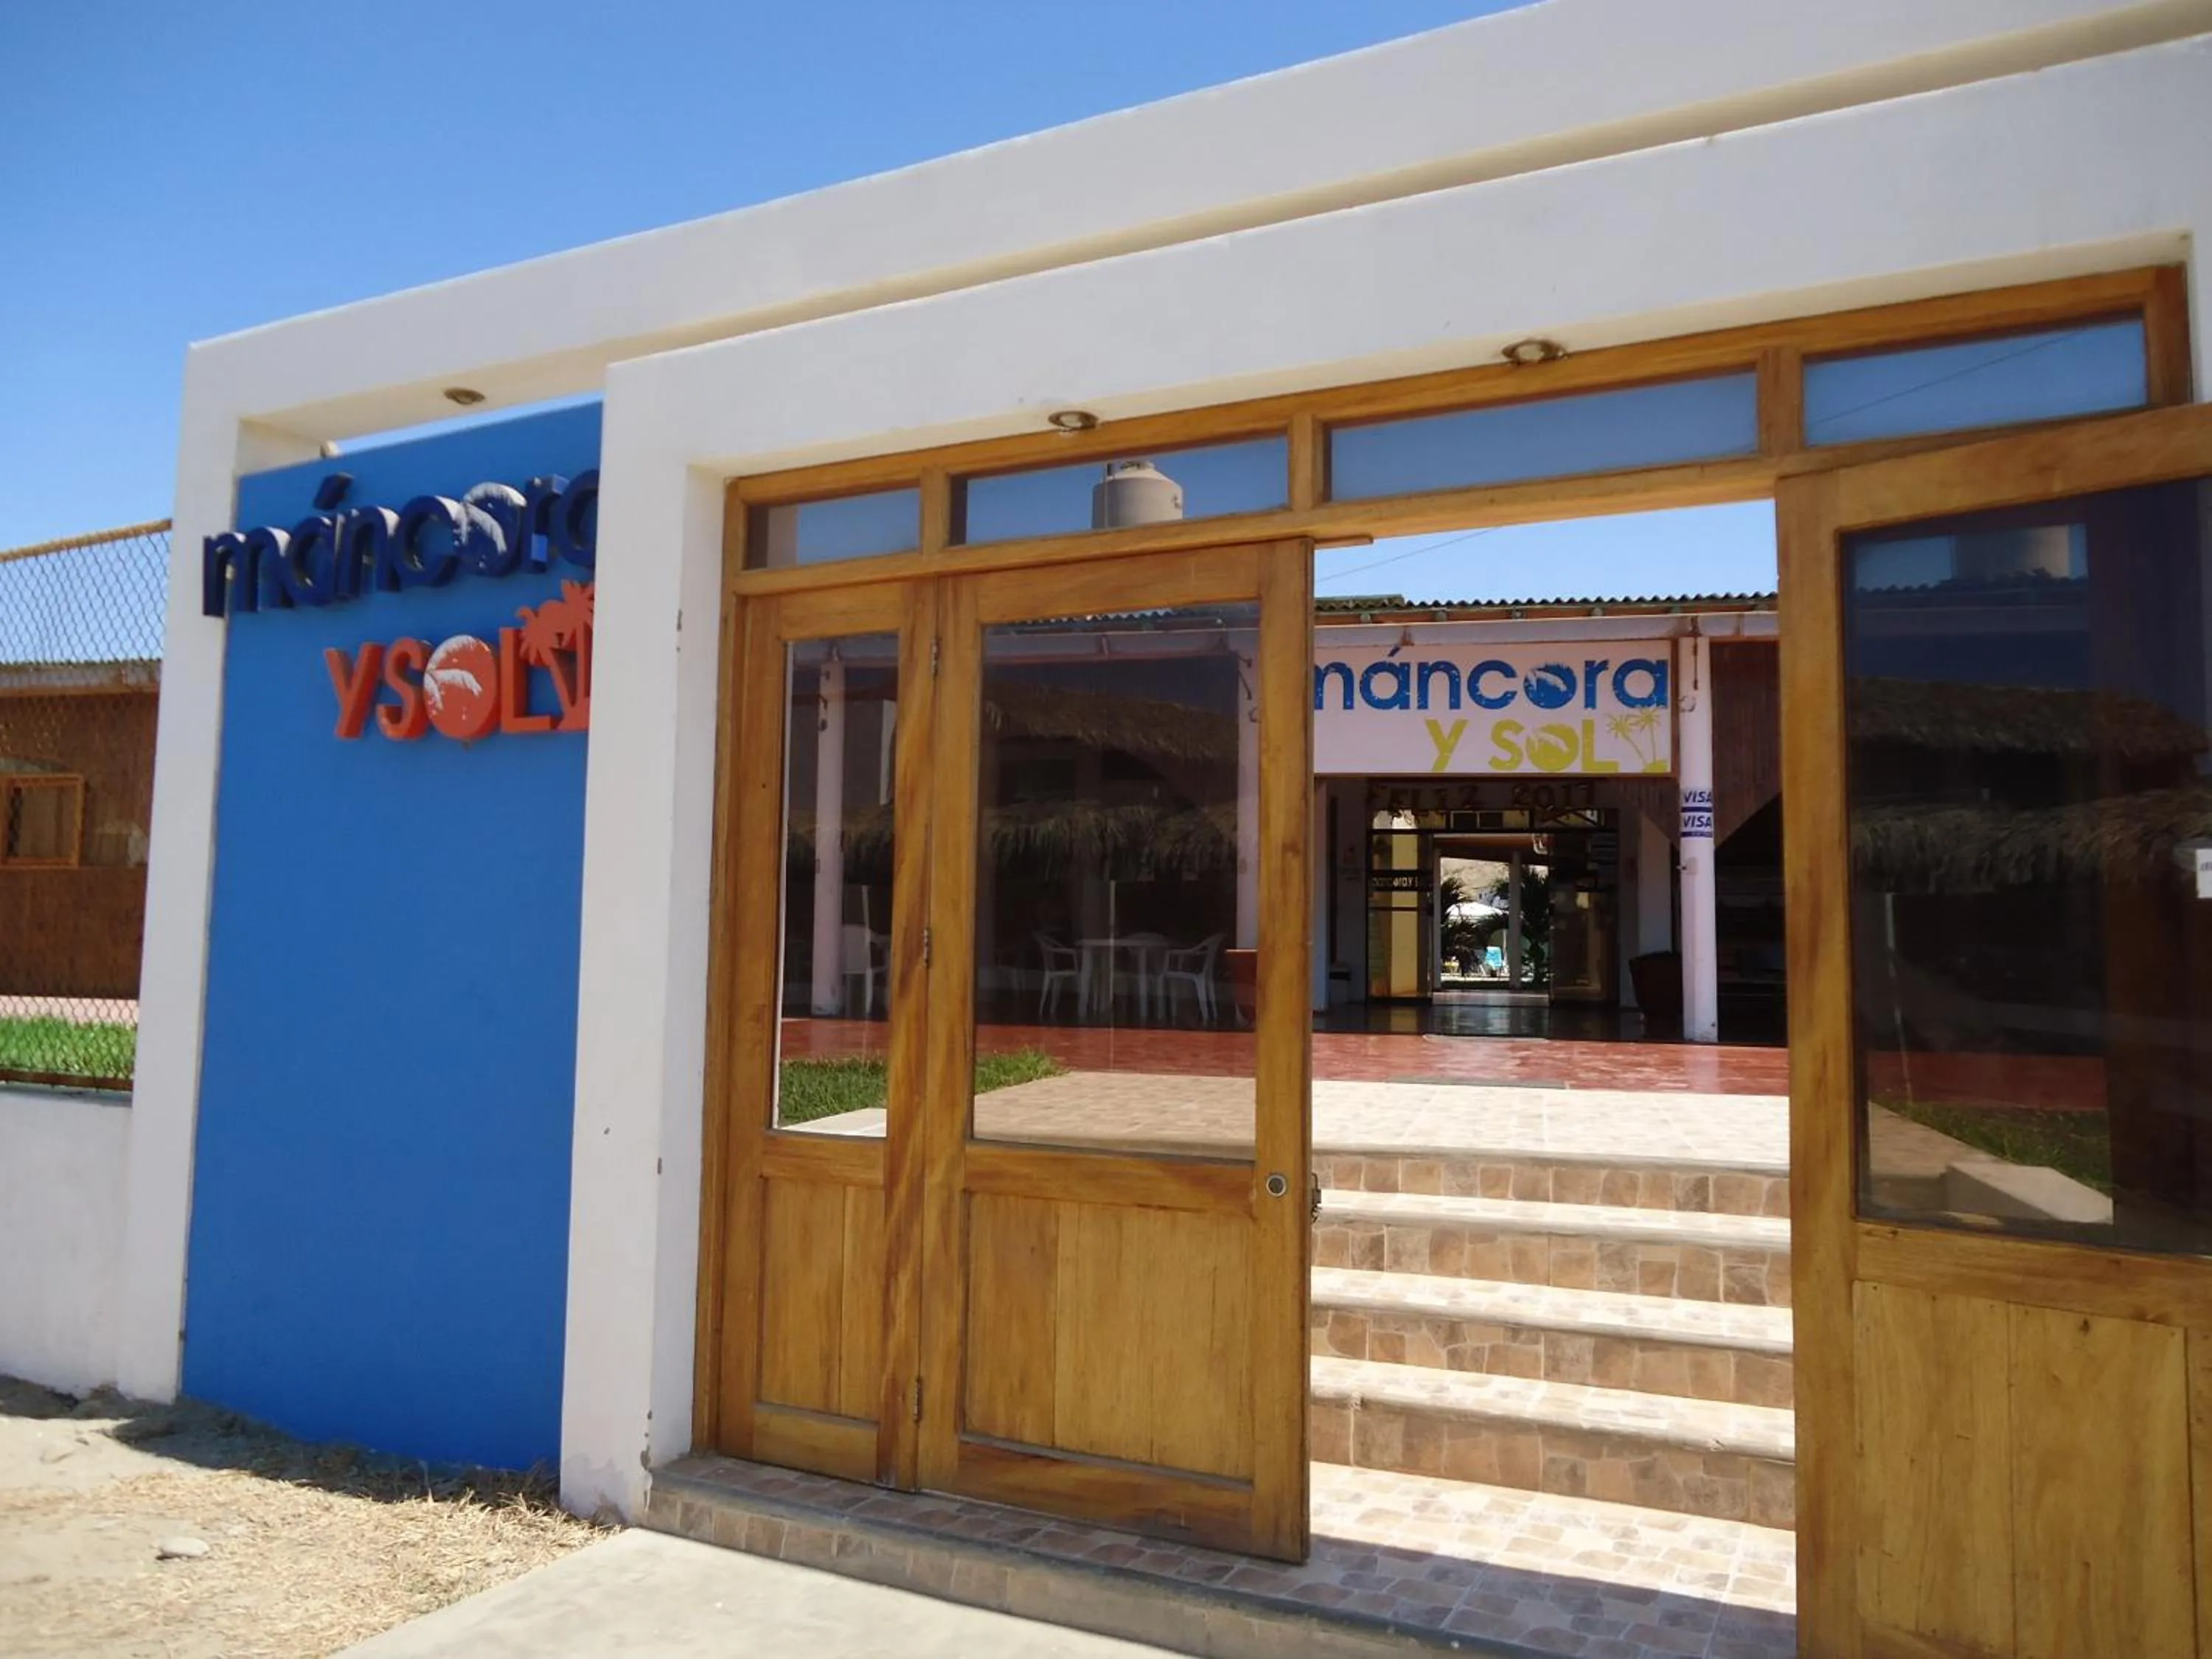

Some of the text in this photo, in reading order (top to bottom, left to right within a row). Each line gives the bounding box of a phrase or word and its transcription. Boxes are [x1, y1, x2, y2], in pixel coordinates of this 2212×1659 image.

[1425, 718, 1620, 773] Y SOL
[1683, 815, 1711, 828] VISA
